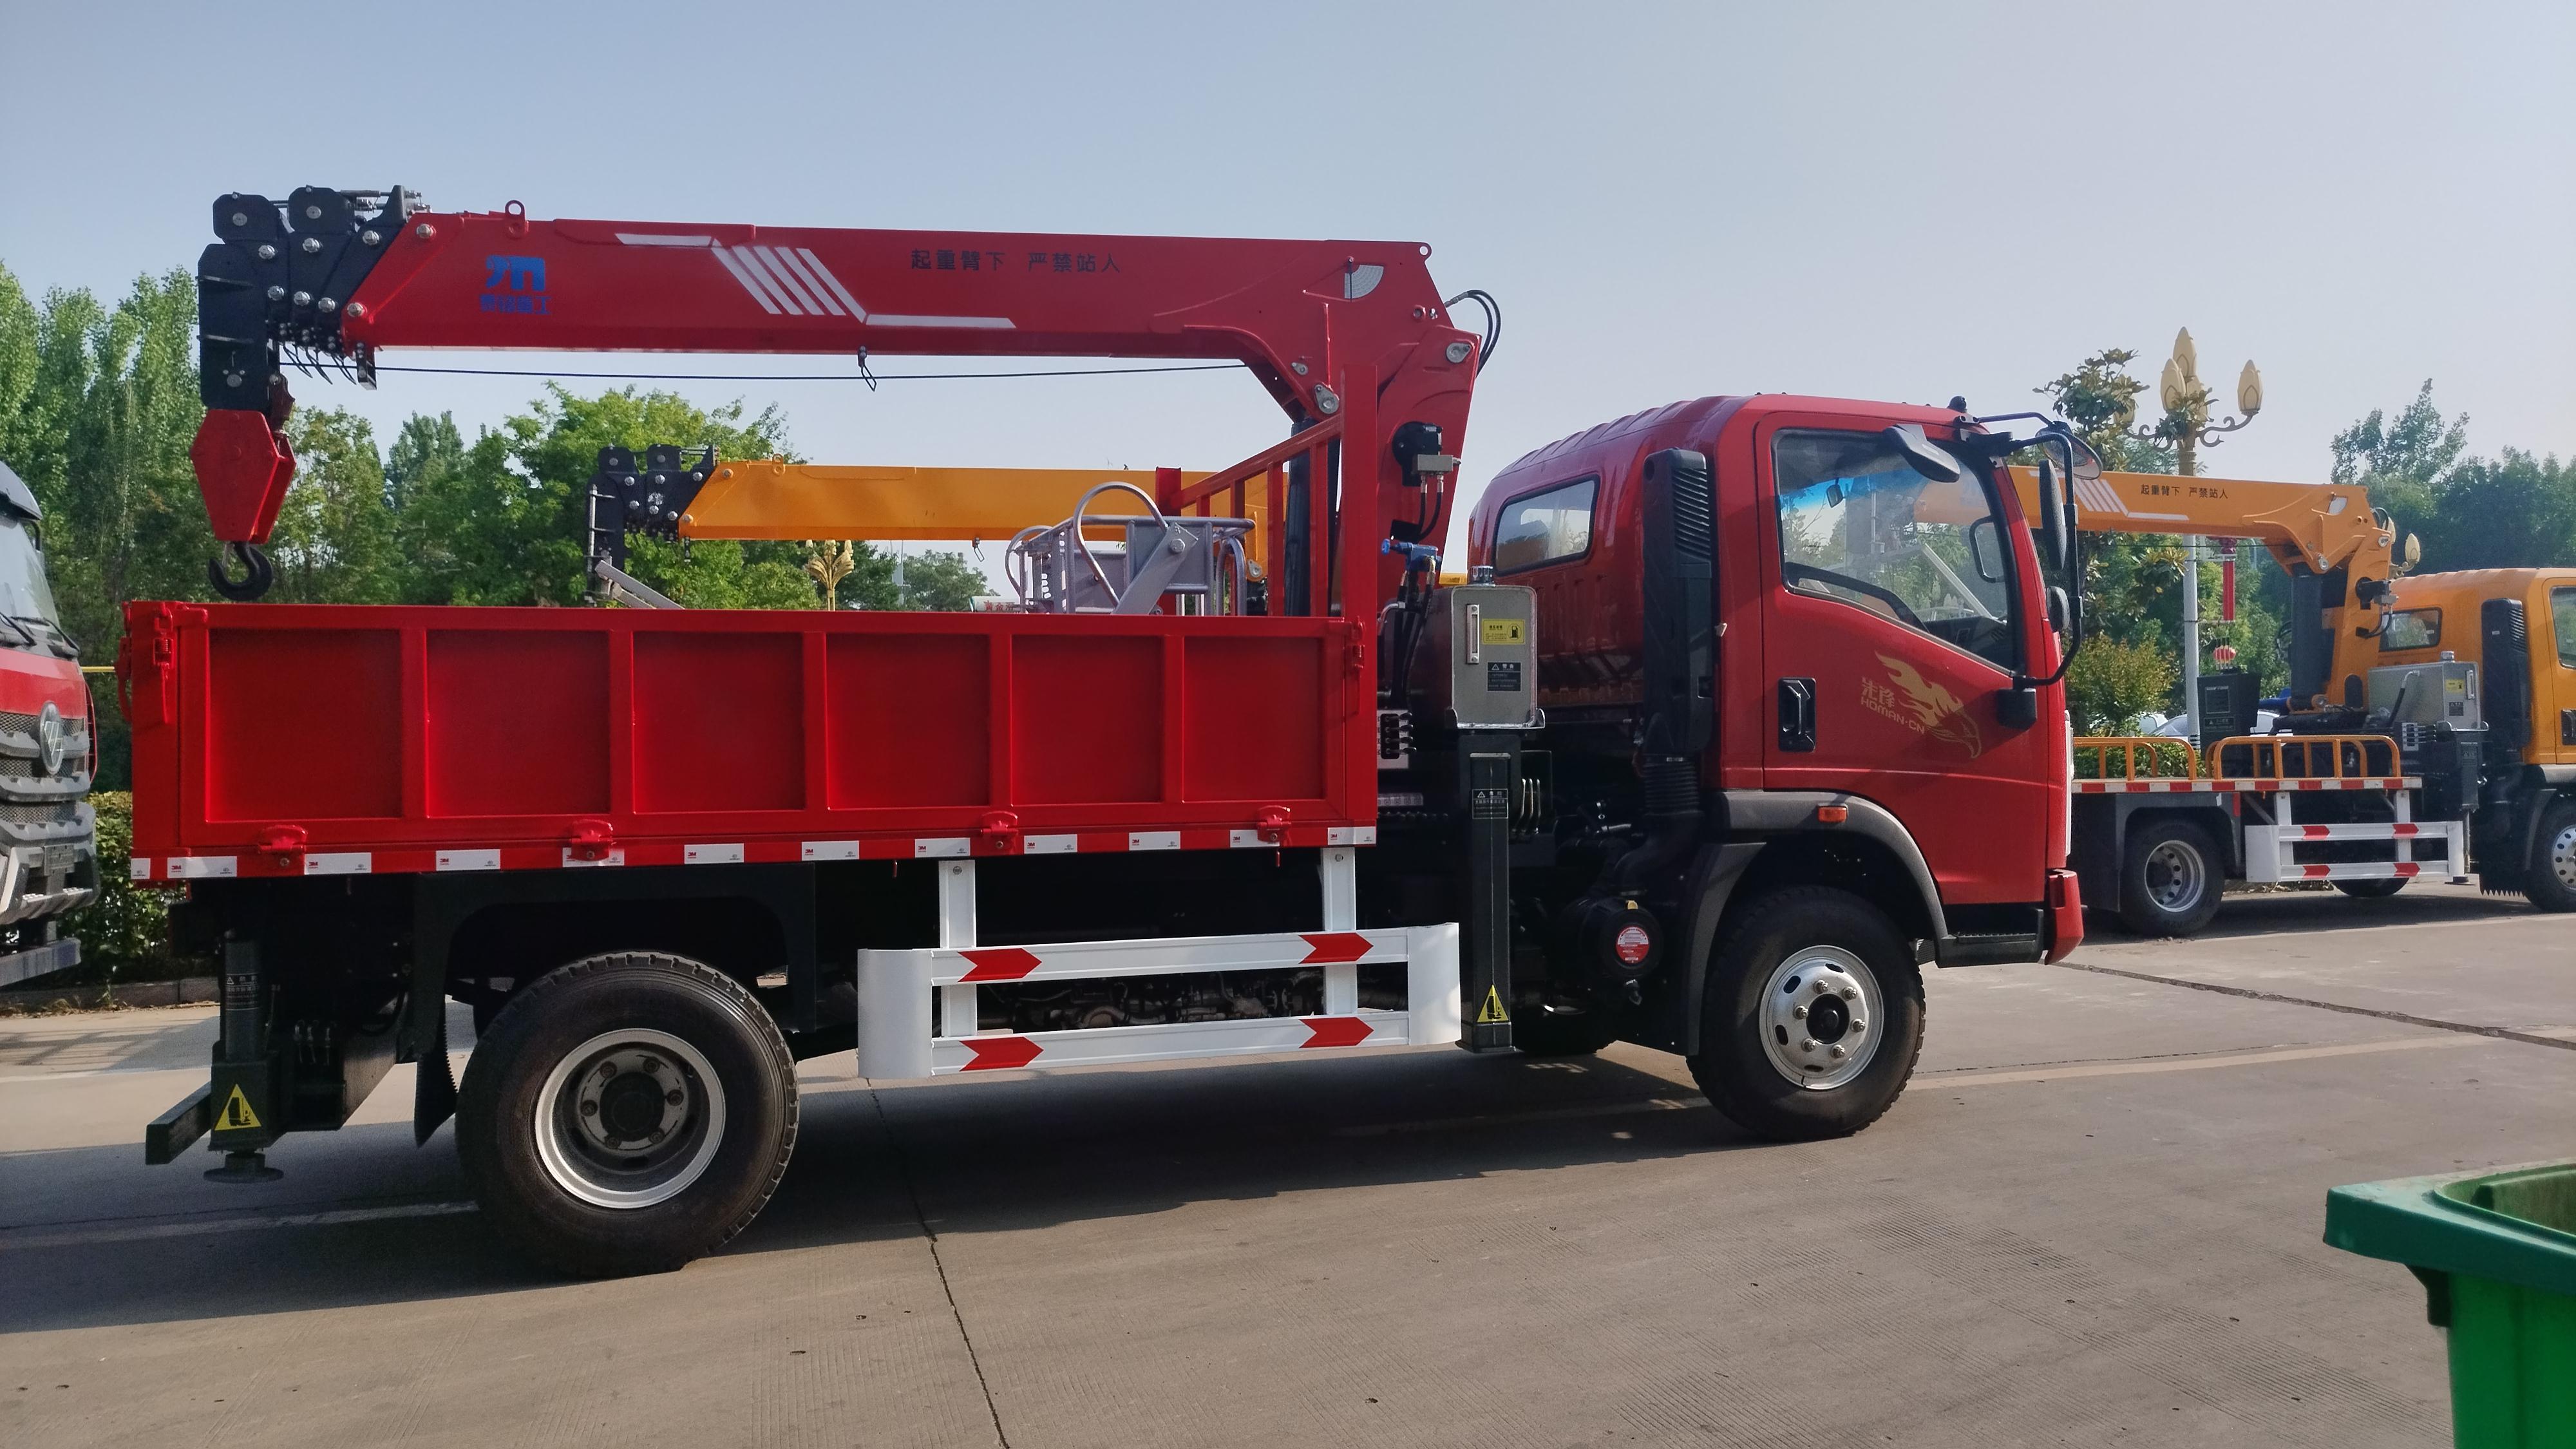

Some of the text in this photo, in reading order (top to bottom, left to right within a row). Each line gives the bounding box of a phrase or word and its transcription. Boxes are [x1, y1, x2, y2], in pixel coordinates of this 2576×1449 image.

[911, 249, 1121, 273] 起重臂下 严禁站人
[2141, 484, 2228, 499] 起重臂下 严禁站人
